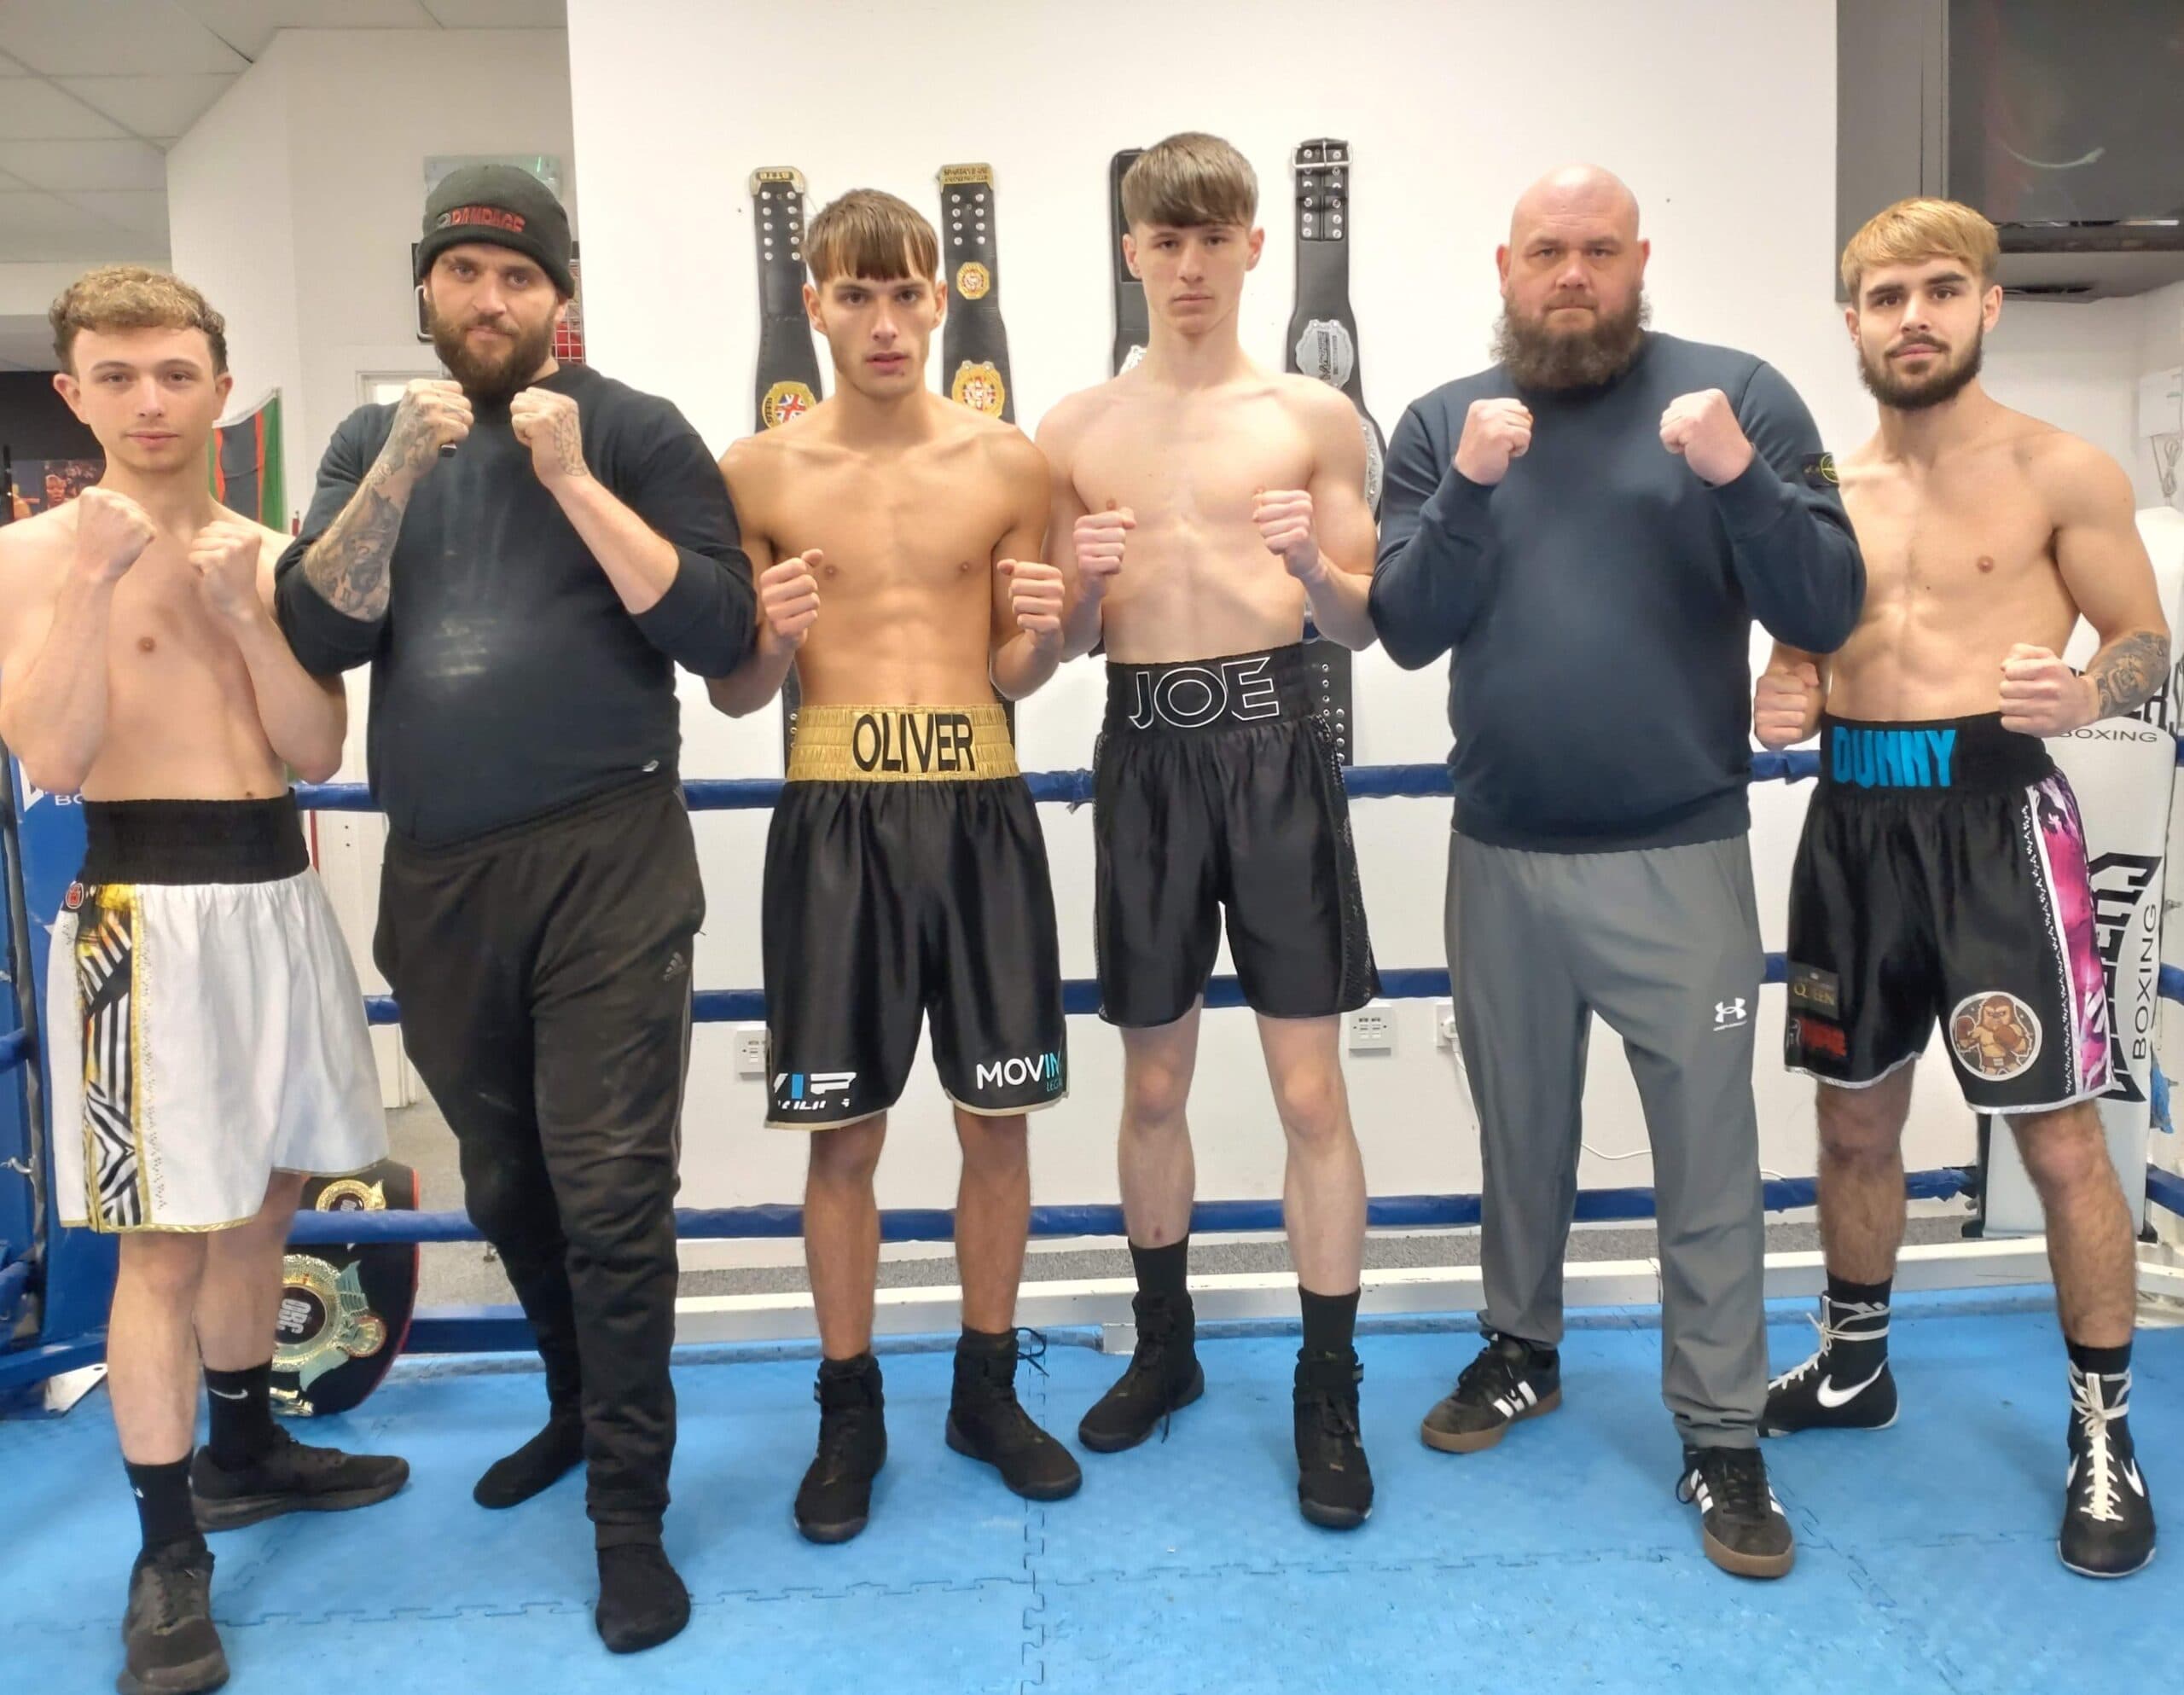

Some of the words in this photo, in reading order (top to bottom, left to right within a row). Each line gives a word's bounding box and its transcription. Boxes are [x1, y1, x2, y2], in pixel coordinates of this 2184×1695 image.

[1128, 656, 1280, 729] JOE
[853, 712, 975, 773] OLIVER
[1833, 726, 1956, 789] DUNNY
[2133, 903, 2157, 1059] BOXING
